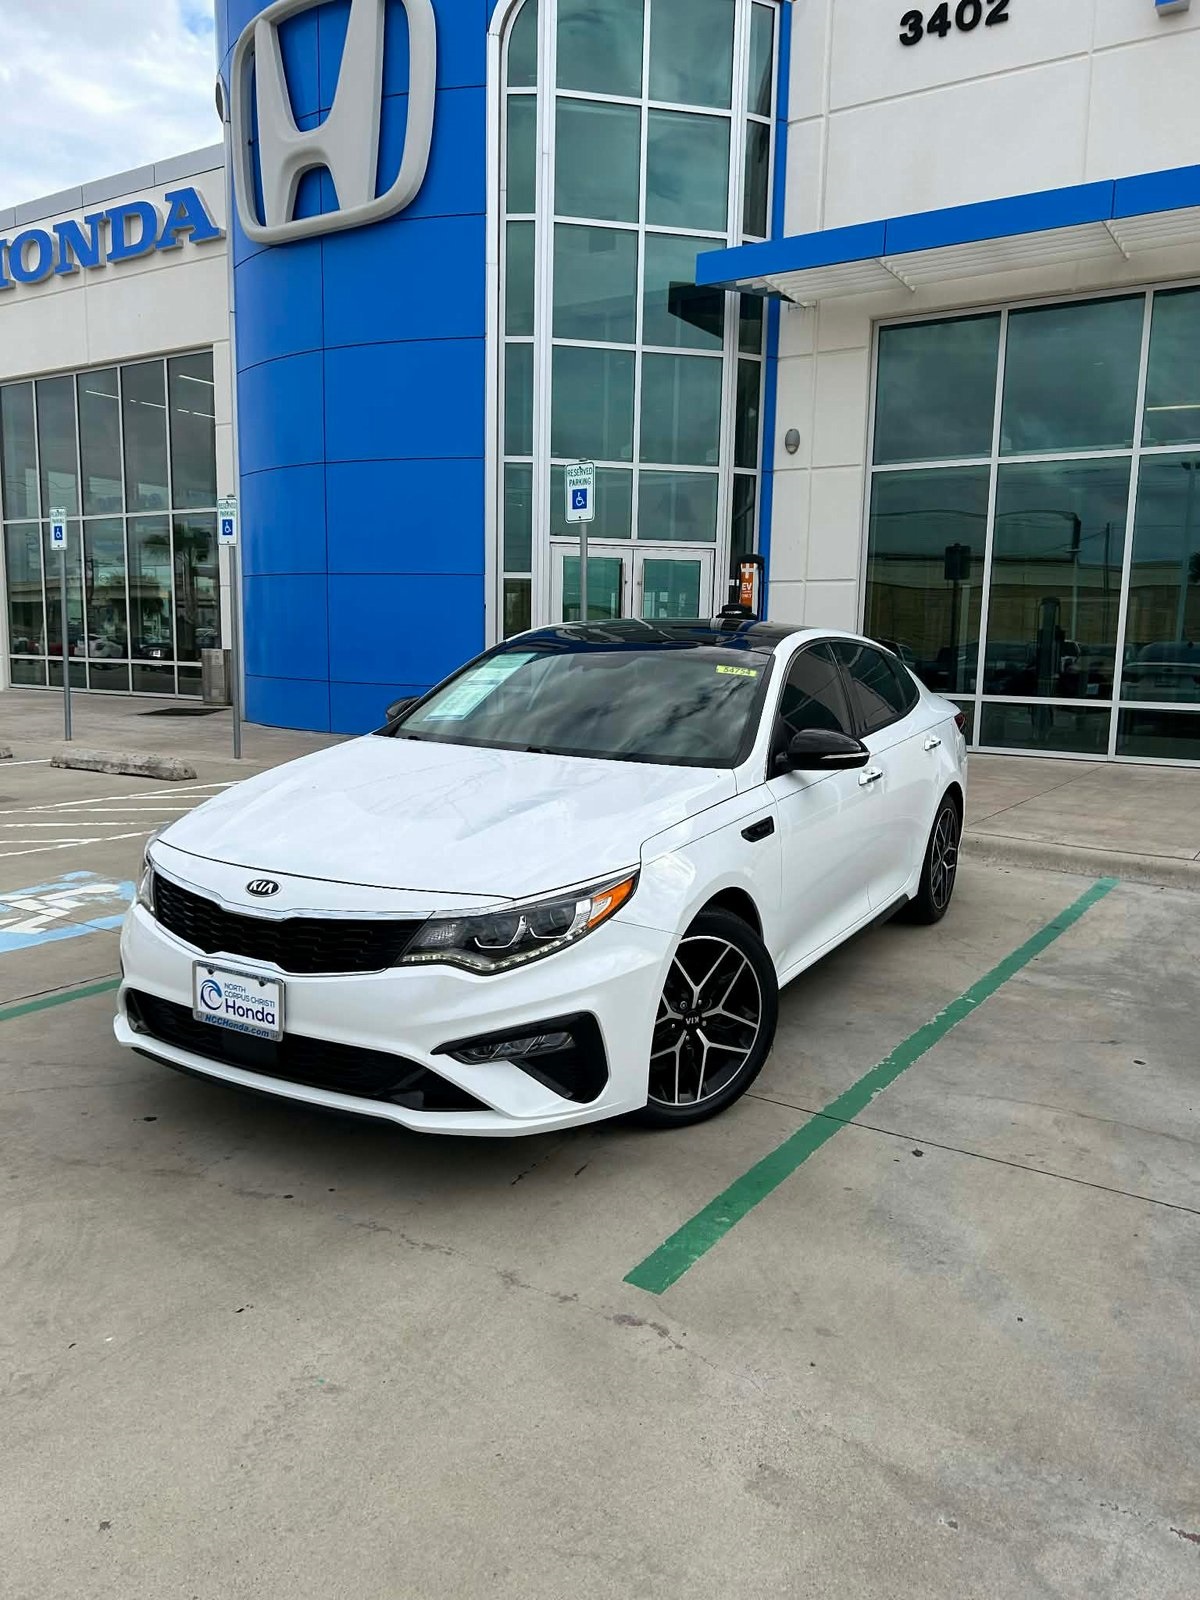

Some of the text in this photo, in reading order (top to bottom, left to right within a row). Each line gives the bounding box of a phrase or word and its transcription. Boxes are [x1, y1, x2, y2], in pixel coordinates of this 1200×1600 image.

[899, 0, 1009, 46] 3402
[568, 466, 592, 477] RESERVED
[569, 478, 592, 487] PARKING
[249, 880, 275, 894] KIA
[224, 982, 246, 993] NORTH
[224, 990, 275, 1008] CORPUS CHRISTI
[225, 998, 275, 1025] Honda
[205, 1014, 270, 1037] NCCHonda.com
